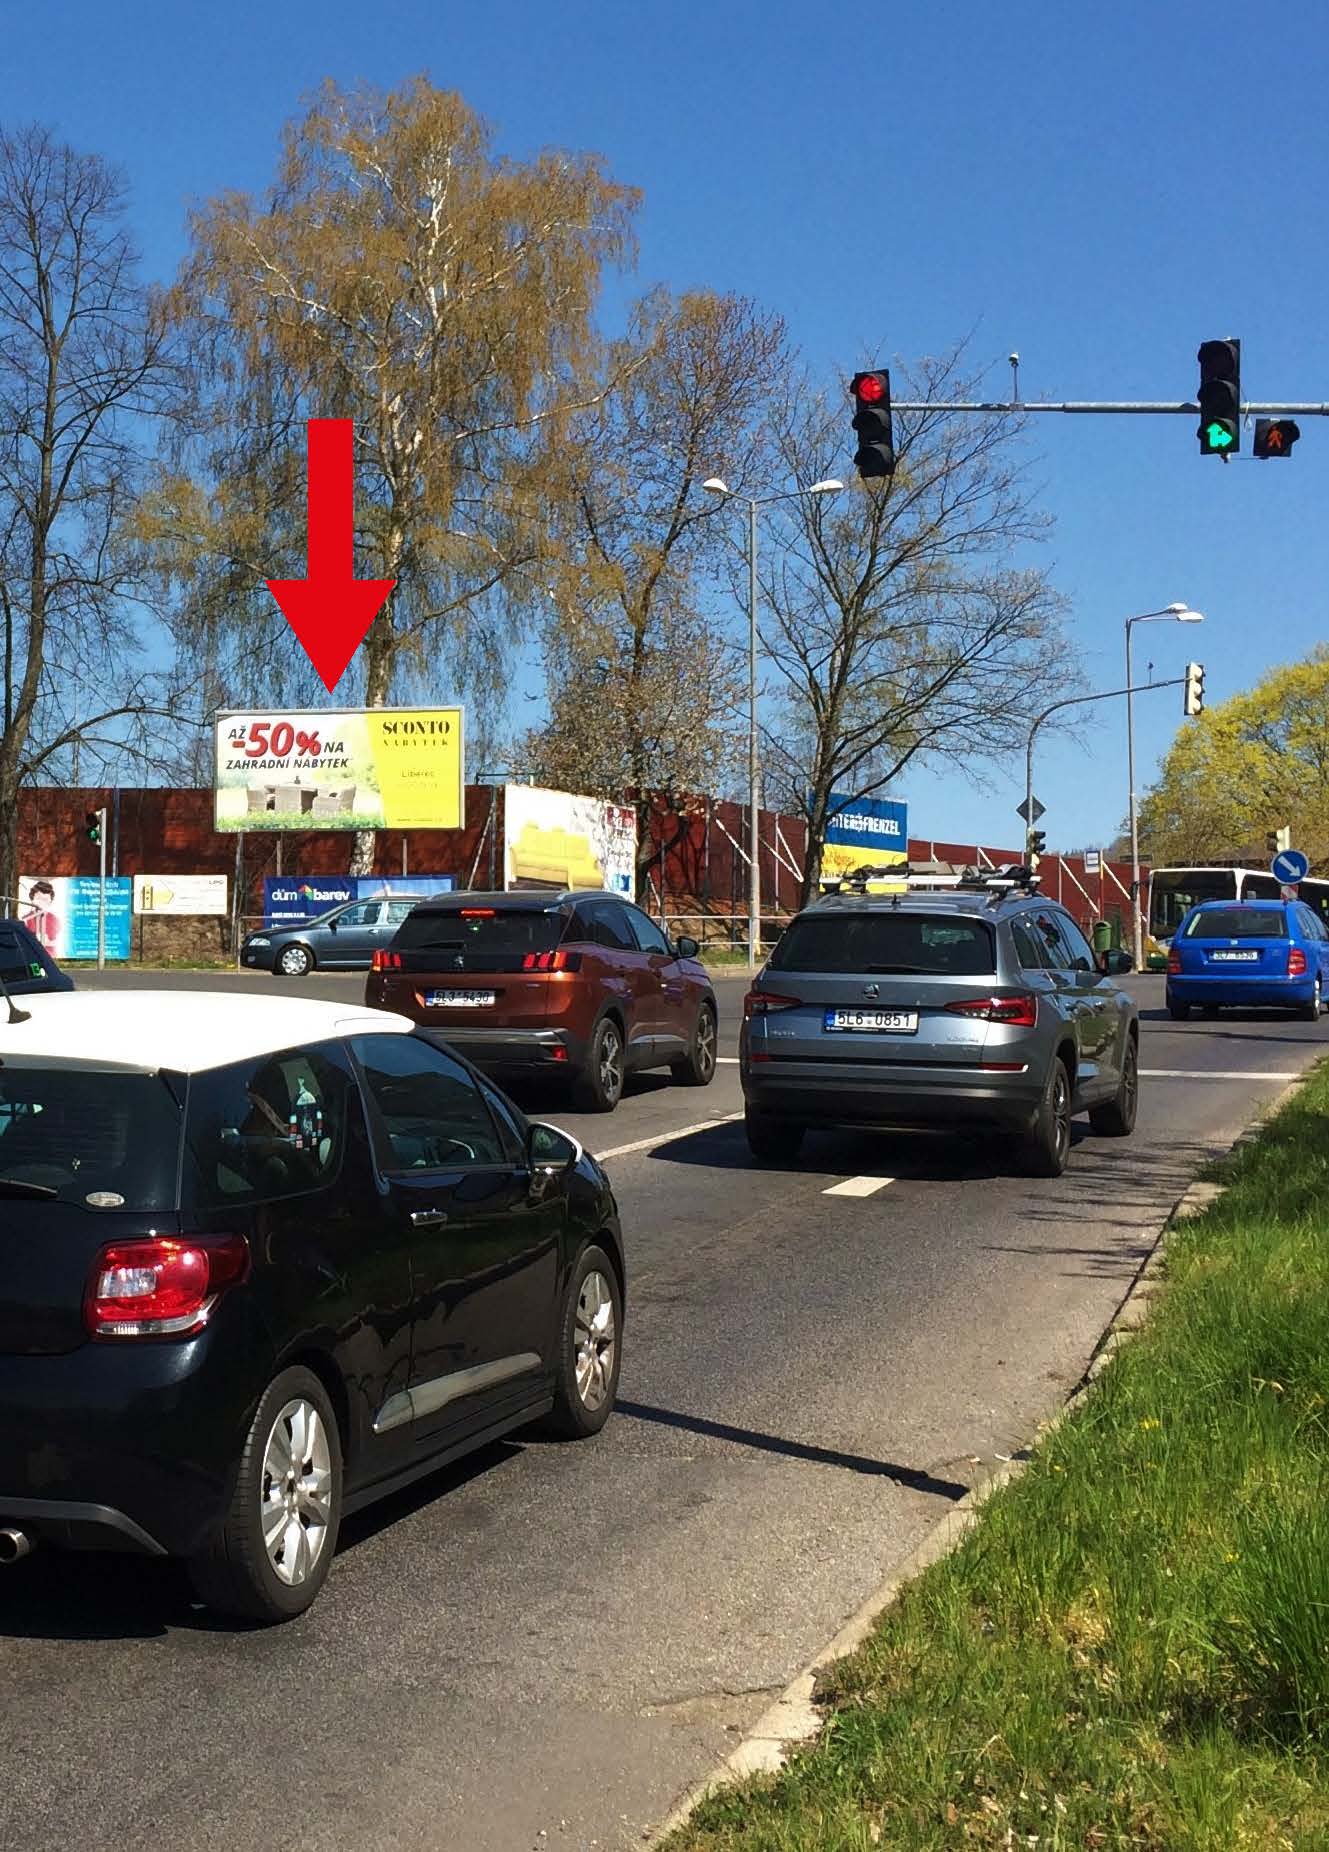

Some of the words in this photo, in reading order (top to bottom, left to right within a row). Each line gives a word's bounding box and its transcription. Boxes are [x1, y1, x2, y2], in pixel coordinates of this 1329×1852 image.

[382, 720, 450, 735] SCONTO
[227, 725, 247, 739] AŽ
[323, 741, 344, 753] NA
[226, 757, 290, 770] ZAHRADNÍ
[312, 888, 351, 901] barev
[837, 1011, 865, 1026] 5L6
[875, 1013, 911, 1028] 0851
